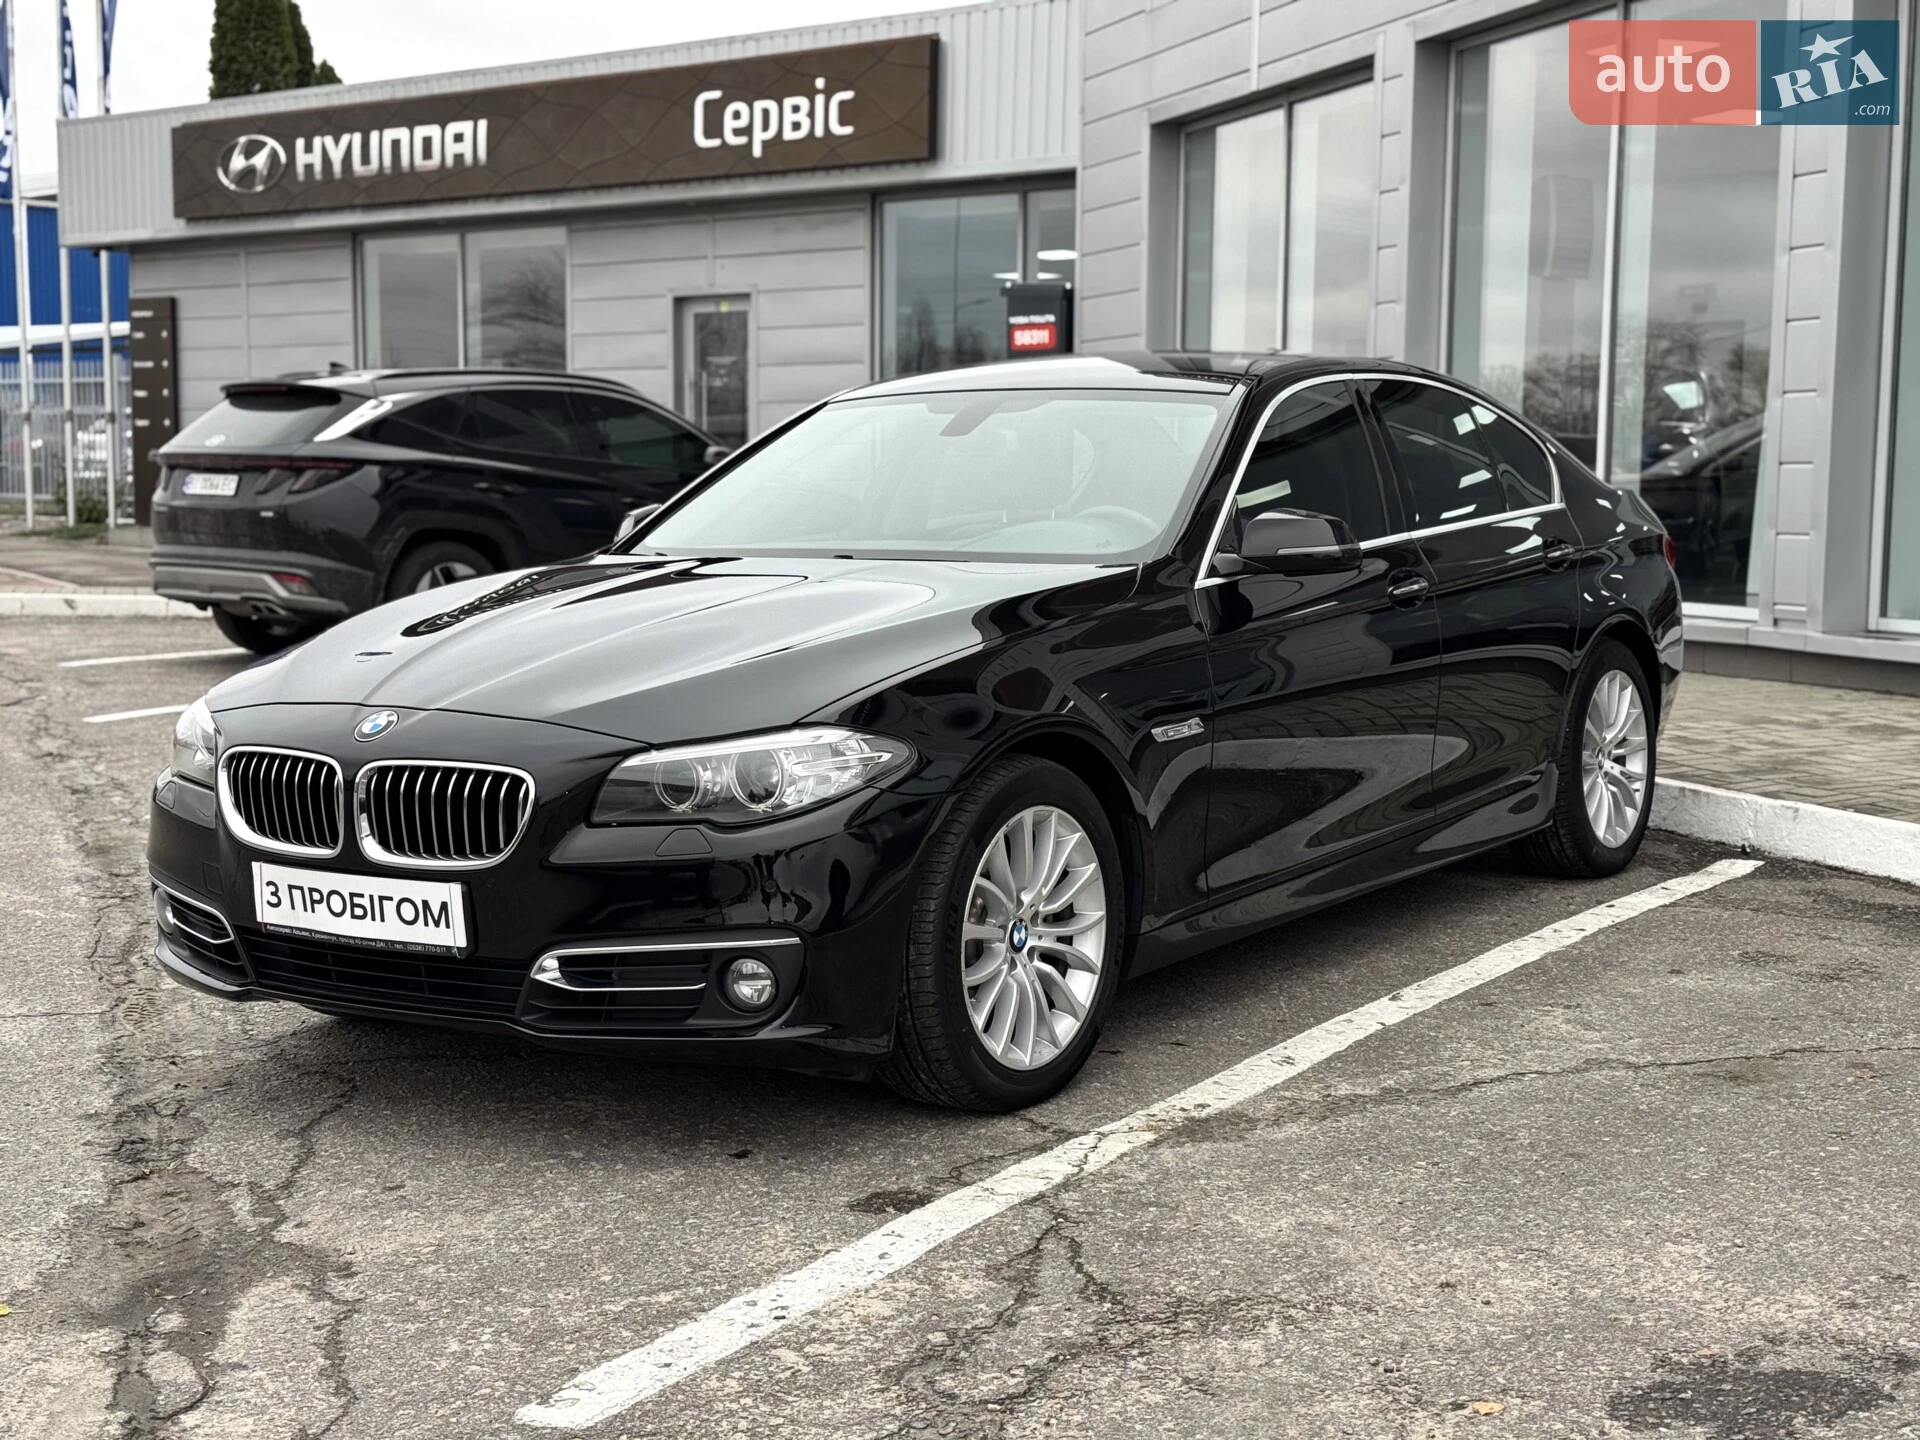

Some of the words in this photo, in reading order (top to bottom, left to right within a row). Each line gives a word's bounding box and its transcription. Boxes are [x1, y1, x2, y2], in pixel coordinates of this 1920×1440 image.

[693, 76, 856, 159] Сервіс
[295, 118, 489, 182] HYUNDAI
[265, 880, 282, 908] З
[287, 884, 451, 929] ПРОБІГОМ
